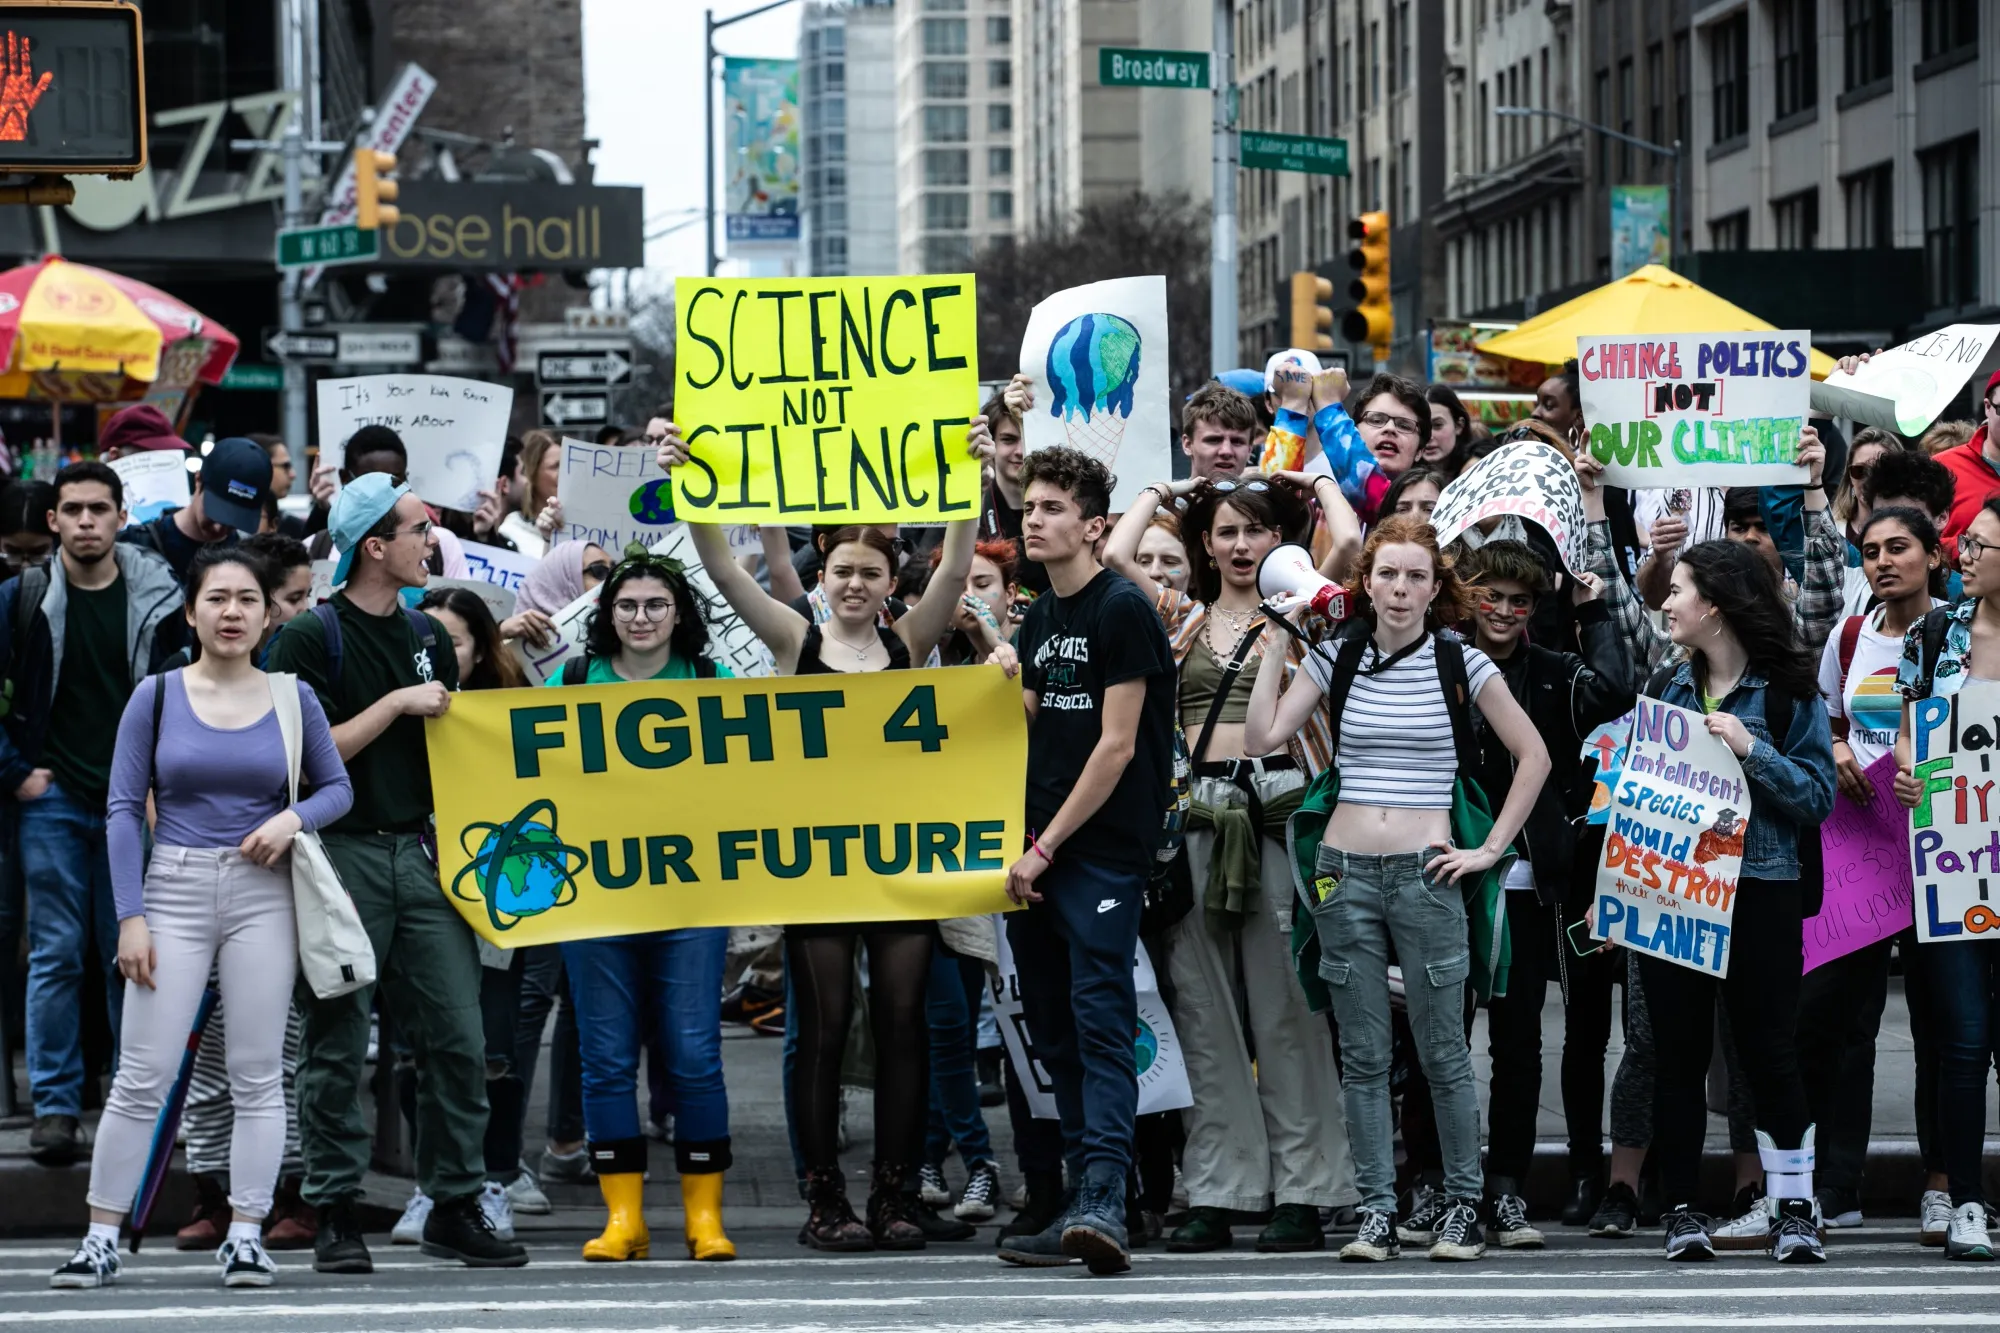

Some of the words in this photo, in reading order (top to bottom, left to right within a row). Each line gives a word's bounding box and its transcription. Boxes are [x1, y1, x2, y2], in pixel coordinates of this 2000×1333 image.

[1111, 53, 1200, 88] Broadway
[502, 205, 600, 260] hall
[686, 284, 968, 391] SCIENCE
[1581, 341, 1682, 382] CHANGE
[1697, 340, 1807, 379] POLITCS
[1917, 332, 1949, 358] IS
[1946, 336, 1983, 364] NO
[339, 385, 370, 411] It's
[1275, 369, 1308, 384] SAVE
[354, 415, 403, 429] THINK
[411, 415, 455, 428] ABOUT
[783, 386, 853, 426] NOT
[680, 417, 971, 514] SILENCE
[1590, 420, 1663, 468] OUR
[1486, 461, 1530, 479] GO
[1054, 692, 1093, 710] SOCER
[509, 689, 845, 779] FIGHT
[883, 684, 949, 753] 4
[1638, 700, 1689, 752] NO
[1632, 746, 1744, 805] intelligent
[1913, 757, 2000, 829] Fir
[717, 820, 1005, 880] FUTURE
[1605, 832, 1736, 912] DESTROY
[1616, 877, 1648, 900] their
[1656, 894, 1681, 911] own
[1597, 895, 1730, 972] PLANET
